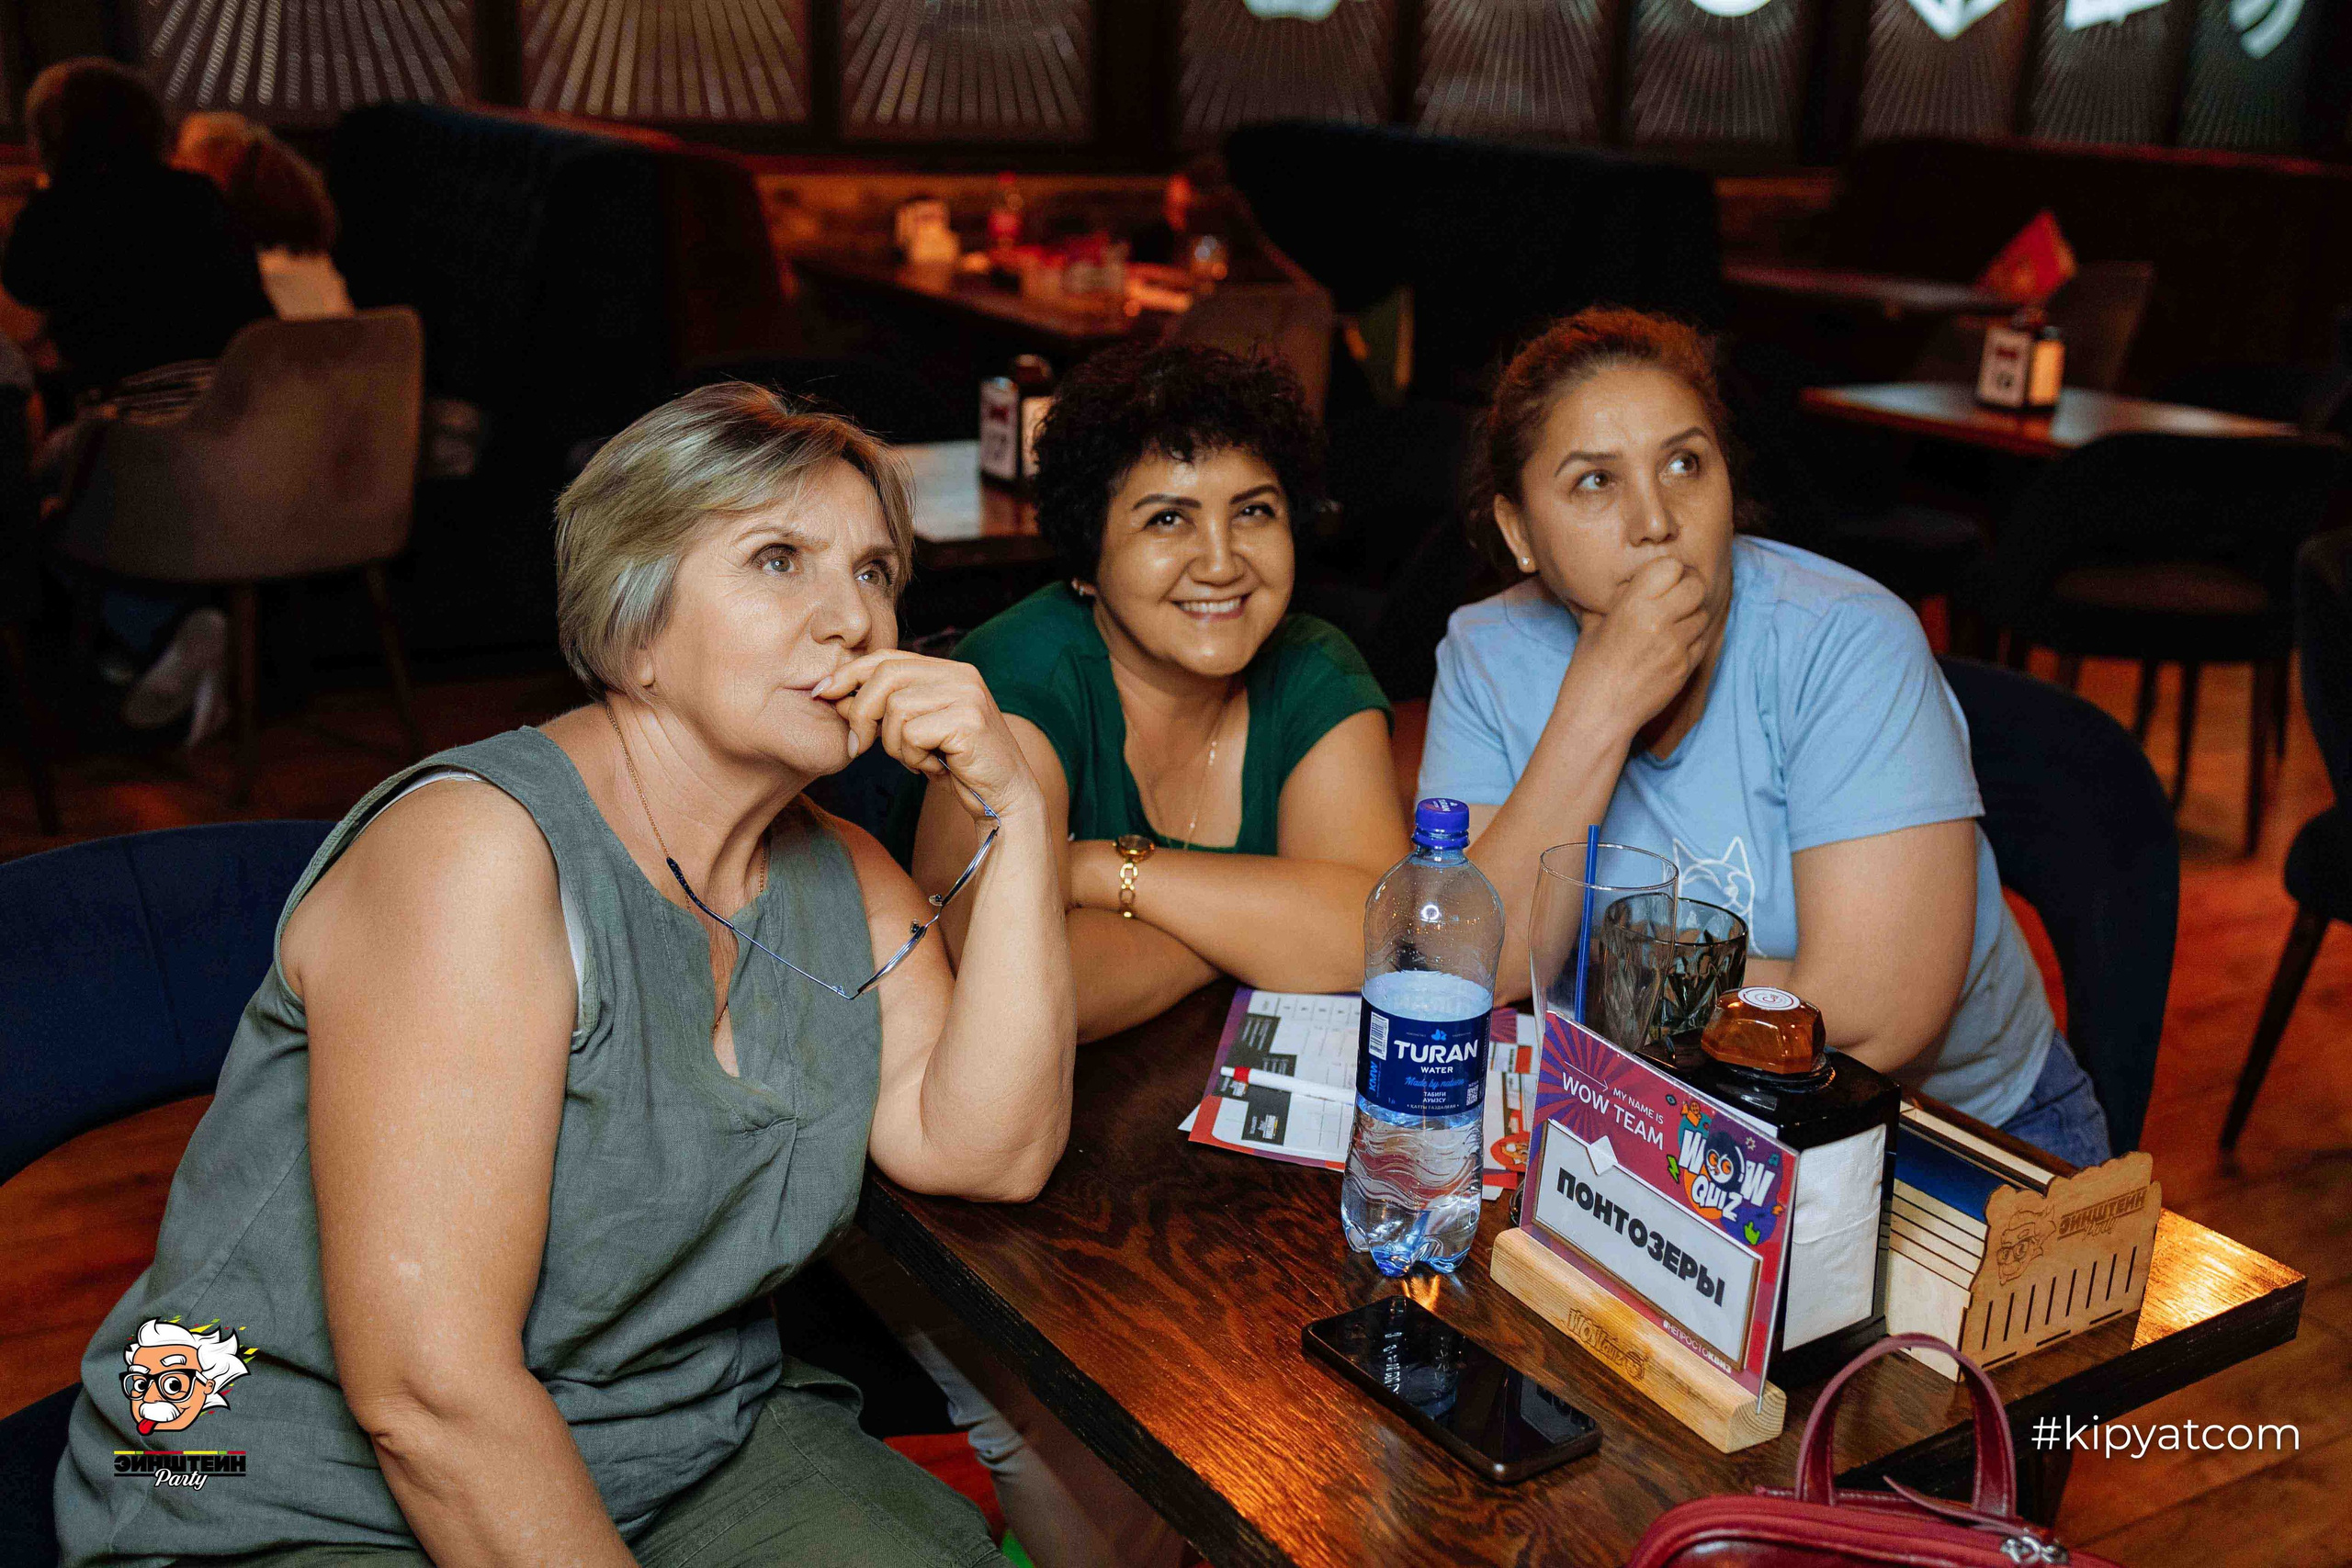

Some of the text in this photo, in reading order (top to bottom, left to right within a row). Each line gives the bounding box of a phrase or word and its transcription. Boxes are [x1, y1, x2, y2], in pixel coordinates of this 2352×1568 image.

[1394, 1039, 1479, 1064] TURAN
[1369, 1060, 1378, 1092] KMW
[1405, 1077, 1428, 1087] Made
[1429, 1078, 1440, 1089] by
[1562, 1072, 1665, 1150] WOW TEAM
[1613, 1088, 1664, 1124] MY NAME IS
[1691, 1175, 1743, 1223] QUIZ
[1556, 1167, 1725, 1307] ПОНТОЗЕРЫ
